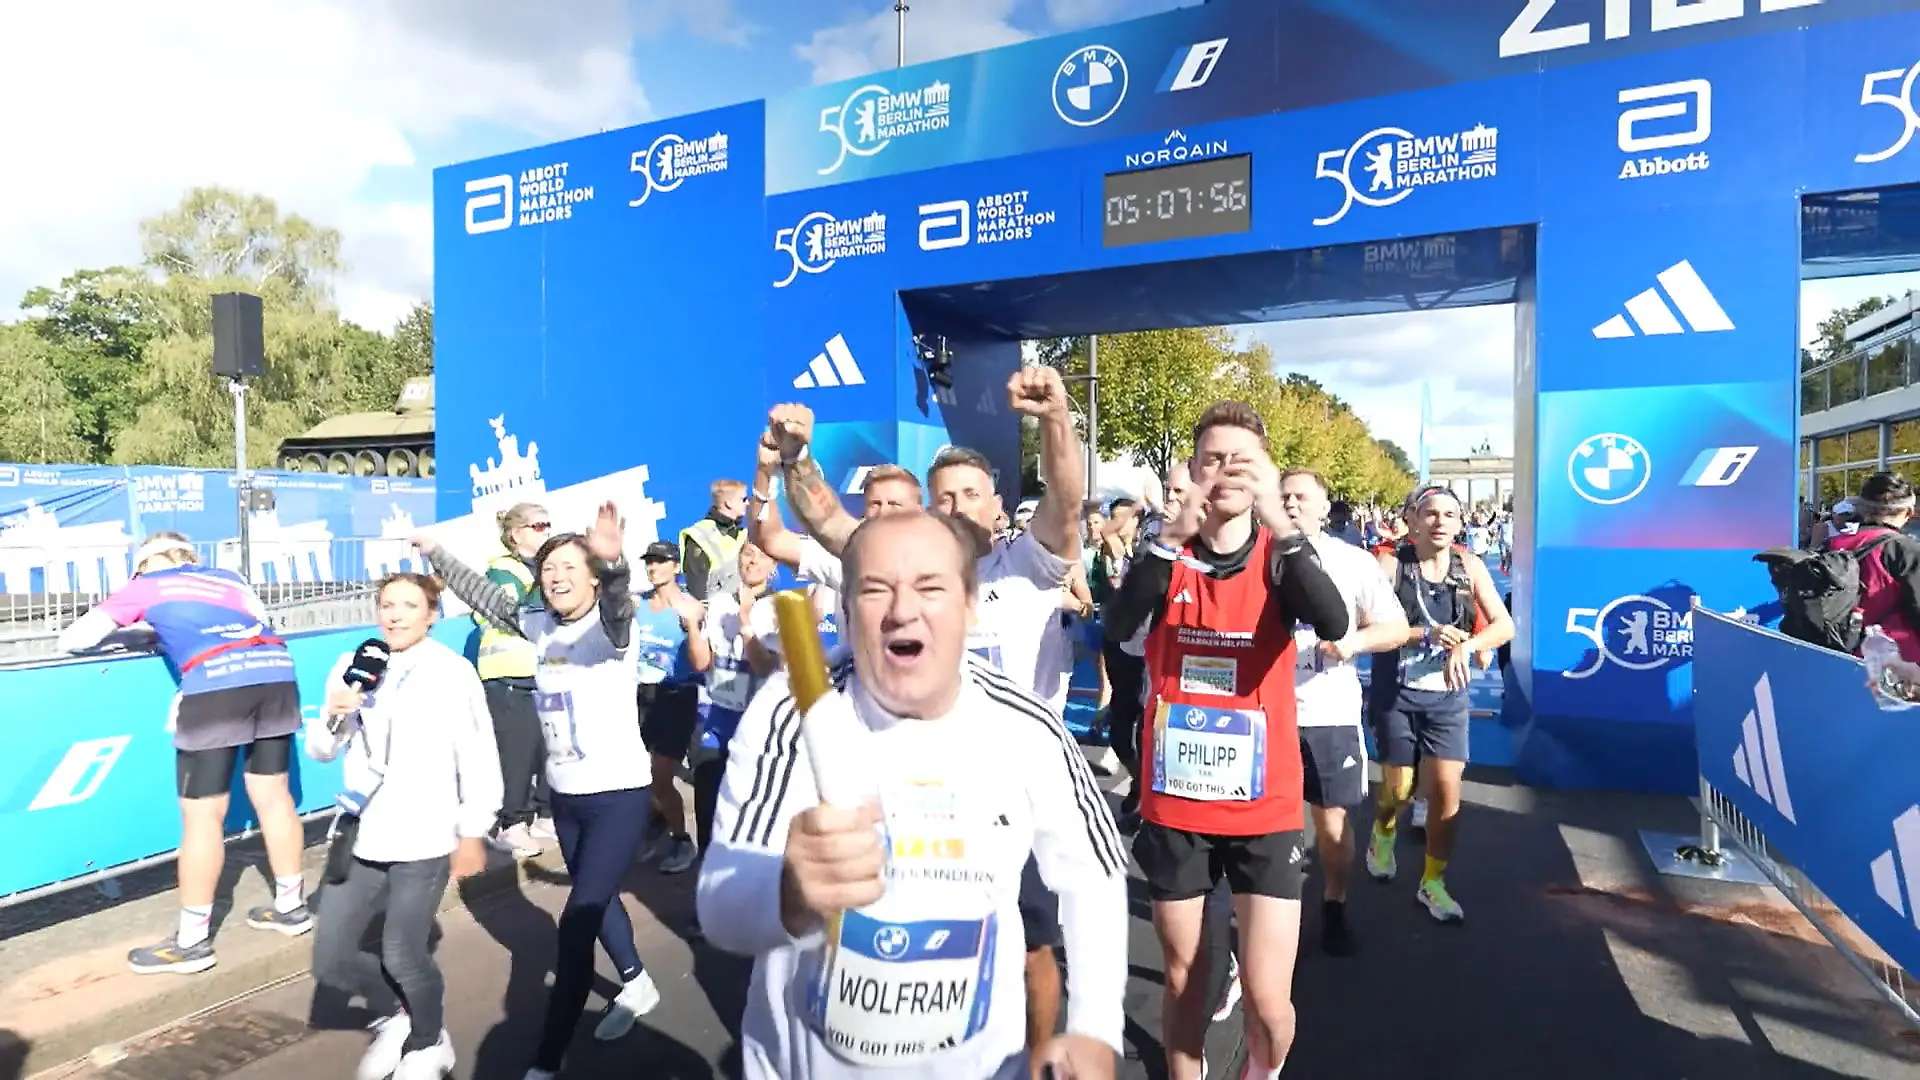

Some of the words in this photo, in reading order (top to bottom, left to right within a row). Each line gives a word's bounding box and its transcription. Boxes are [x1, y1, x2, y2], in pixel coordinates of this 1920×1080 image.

[877, 88, 922, 114] BMW
[877, 106, 923, 128] BERLIN
[877, 115, 950, 141] MARATHON
[673, 141, 708, 158] BMW
[1125, 139, 1228, 168] NORQAIN
[1396, 133, 1459, 160] BMW
[673, 154, 709, 169] BERLIN
[673, 160, 728, 179] MARATHON
[1396, 152, 1459, 175] BERLIN
[1618, 151, 1710, 180] Abbott
[519, 162, 569, 185] ABBOTT
[1396, 163, 1497, 189] MARATHON
[519, 178, 564, 197] WORLD
[519, 186, 594, 212] MARATHON
[976, 190, 1029, 209] ABBOTT
[1106, 179, 1248, 228] 05:07:56
[519, 206, 573, 226] MAJORS
[976, 203, 1025, 219] WORLD
[824, 218, 863, 238] BMW
[976, 211, 1056, 234] MARATHON
[824, 232, 863, 250] BERLIN
[976, 227, 1033, 245] MAJORS
[824, 241, 886, 261] MARATHON
[1653, 611, 1693, 629] BM
[1177, 741, 1238, 768] PHILIPP
[1168, 778, 1186, 791] YOU
[1187, 780, 1204, 792] GOT
[1205, 782, 1226, 795] THIS
[838, 967, 968, 1015] WOLFRAM
[828, 1025, 855, 1049] YOU
[860, 1040, 887, 1056] GOT
[894, 1041, 925, 1056] THIS
